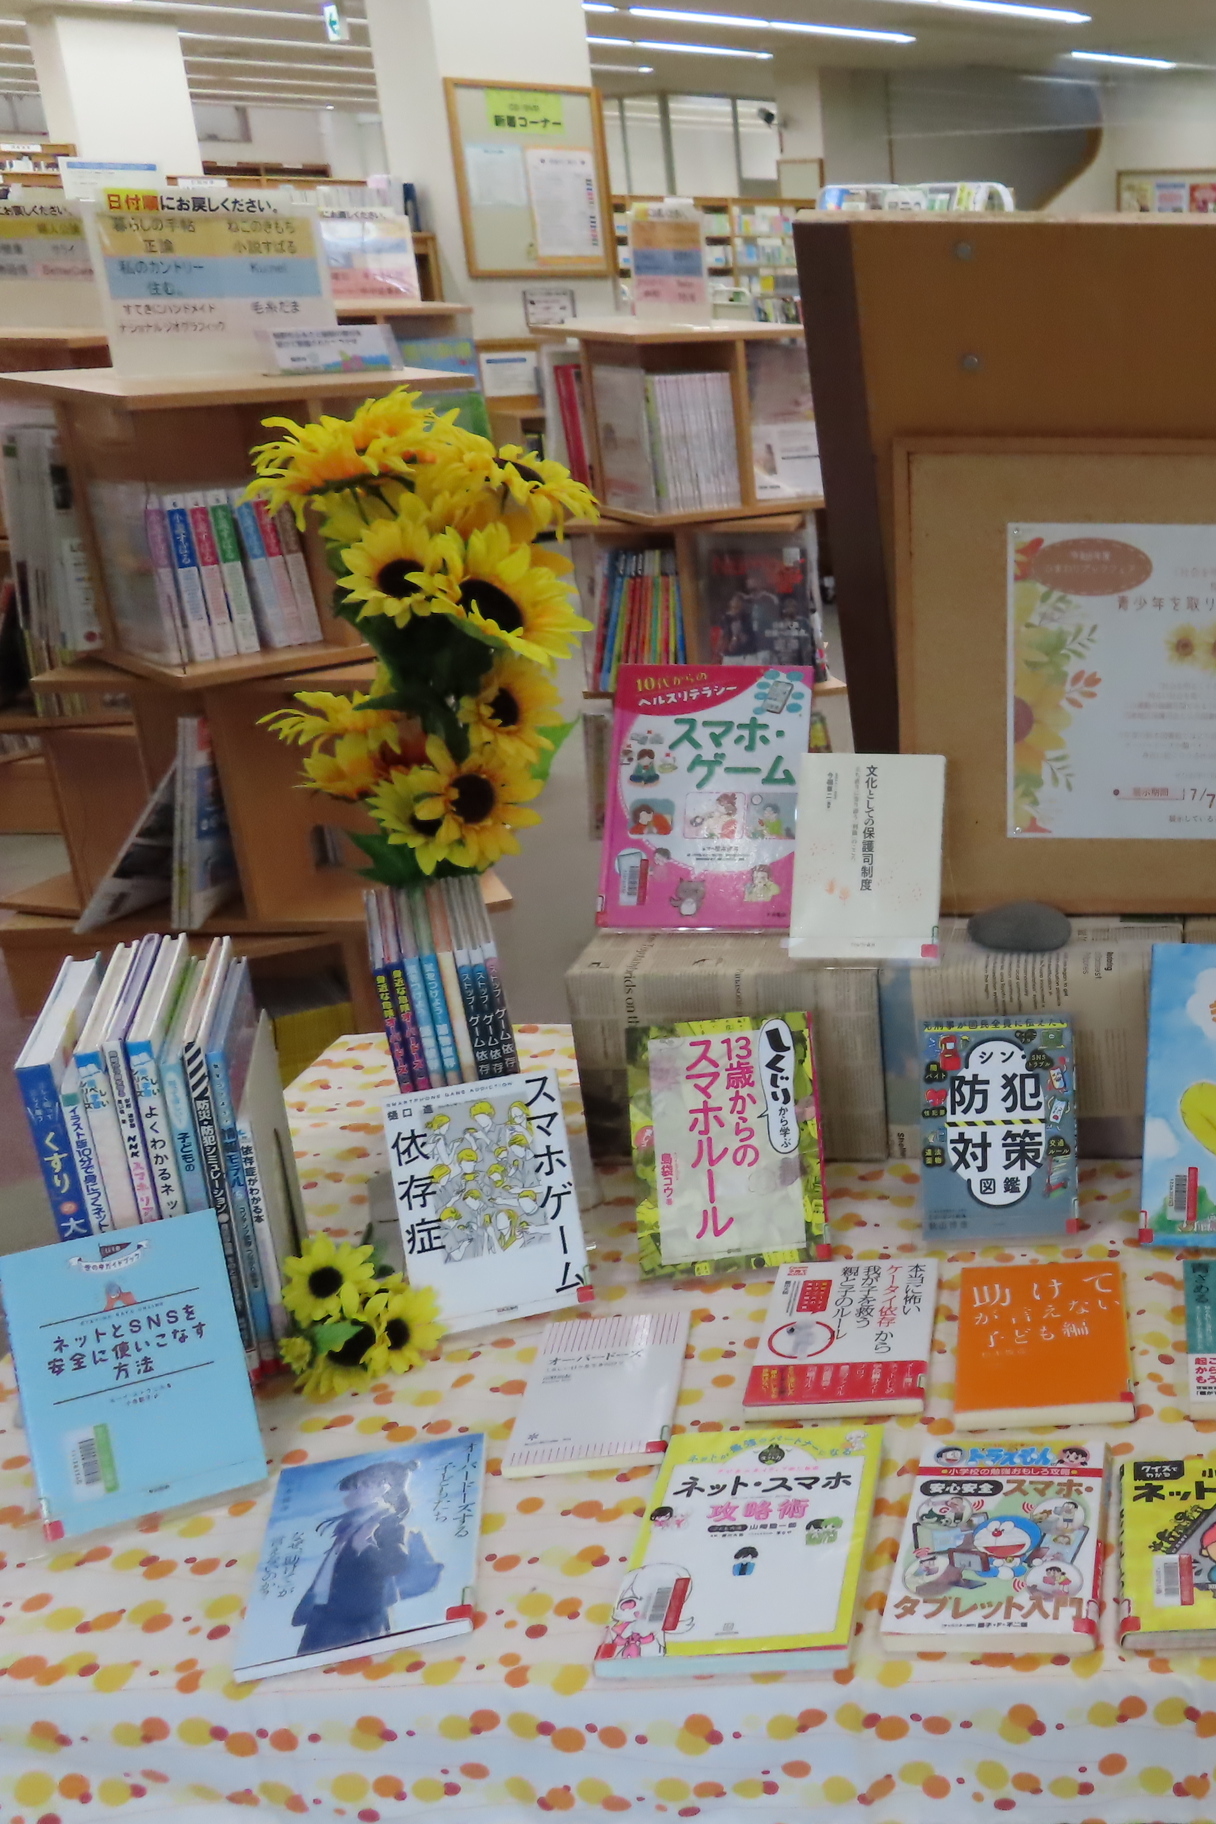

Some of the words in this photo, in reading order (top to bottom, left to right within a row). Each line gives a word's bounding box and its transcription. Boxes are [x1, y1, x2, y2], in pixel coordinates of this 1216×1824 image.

[493, 114, 562, 128] 新着コーナー
[107, 193, 279, 215] 日付順にお戻しください。
[635, 672, 708, 692] 10代からの
[638, 685, 738, 707] ヘルスリテラシー
[668, 716, 786, 752] スマホ・
[686, 753, 797, 790] ゲーム
[860, 765, 878, 892] 文化としての保護司制度
[469, 1014, 490, 1075] ゲーム依存
[483, 1013, 504, 1074] ゲーム依存
[495, 1008, 516, 1068] ゲーム依存
[923, 1020, 1066, 1030] 元刑事が国民全員に伝えたい
[719, 1036, 760, 1168] 13歳からの
[764, 1027, 793, 1149] しくじりから学ぶ
[950, 1072, 1044, 1116] 防犯
[145, 1105, 178, 1217] よくわかるネッ
[685, 1039, 735, 1240] スマホルール
[949, 1128, 1044, 1173] 対策
[240, 1144, 265, 1224] 依存症がわかる本
[390, 1128, 448, 1257] 依存症
[523, 1073, 587, 1296] スマホゲーム
[979, 1176, 1022, 1195] 図鑑
[828, 1266, 860, 1341] 親と子のルール
[854, 1265, 882, 1329] 我が子を救う
[874, 1264, 903, 1355] ケータイ依存から
[902, 1263, 927, 1316] 本当に怖い
[973, 1272, 1113, 1308] 助けて
[47, 1321, 207, 1376] 安全に使いこなす
[52, 1303, 196, 1353] ネットとSNSを
[988, 1318, 1090, 1348] 子ども編
[112, 1355, 154, 1381] 方法
[549, 1349, 645, 1366] オーバードーズ
[452, 1442, 478, 1538] オーバードーズする
[672, 1471, 853, 1498] ネット・スマホ
[929, 1482, 994, 1494] 安心安全
[948, 1468, 1071, 1476] 小学校の勉強おもしろ攻略
[1141, 1464, 1178, 1473] クイズで
[432, 1461, 456, 1523] 子どもたち
[706, 1498, 810, 1522] 攻略術
[893, 1594, 1084, 1621] タブレット入門
